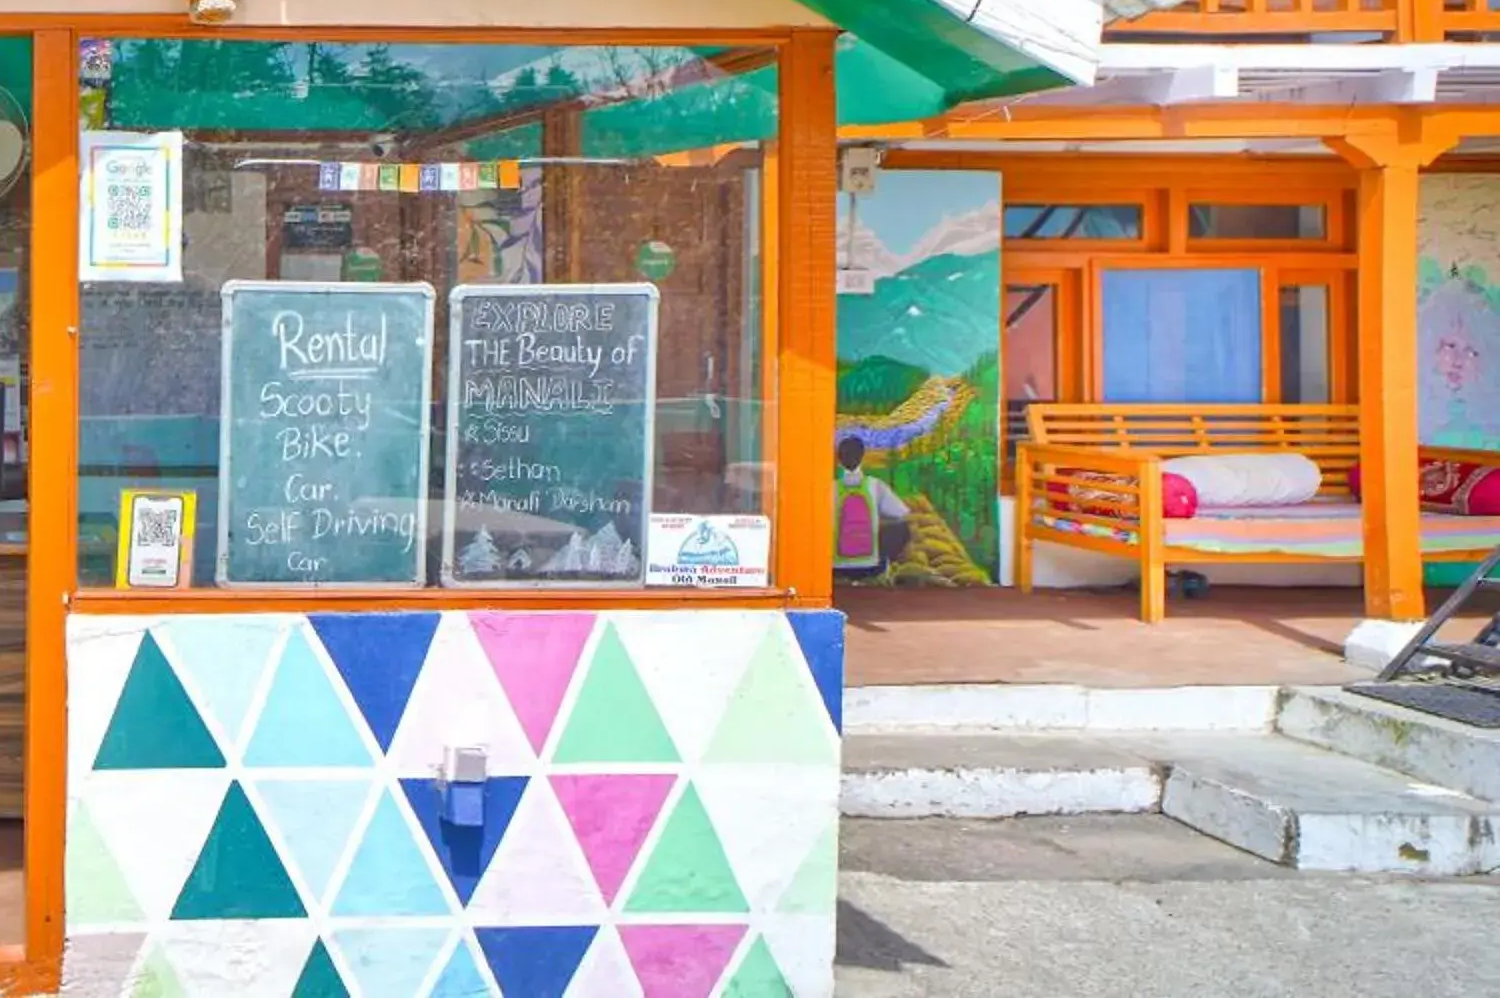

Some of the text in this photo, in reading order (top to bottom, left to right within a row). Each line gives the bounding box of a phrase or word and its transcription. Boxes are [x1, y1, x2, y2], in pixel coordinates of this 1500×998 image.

[272, 309, 387, 369] Rental
[470, 300, 616, 333] EXPLORE
[464, 332, 645, 378] THE Beauty of
[260, 381, 372, 430] Scooty
[463, 375, 616, 414] MANALI
[311, 507, 416, 552] Driving
[286, 550, 329, 572] Car
